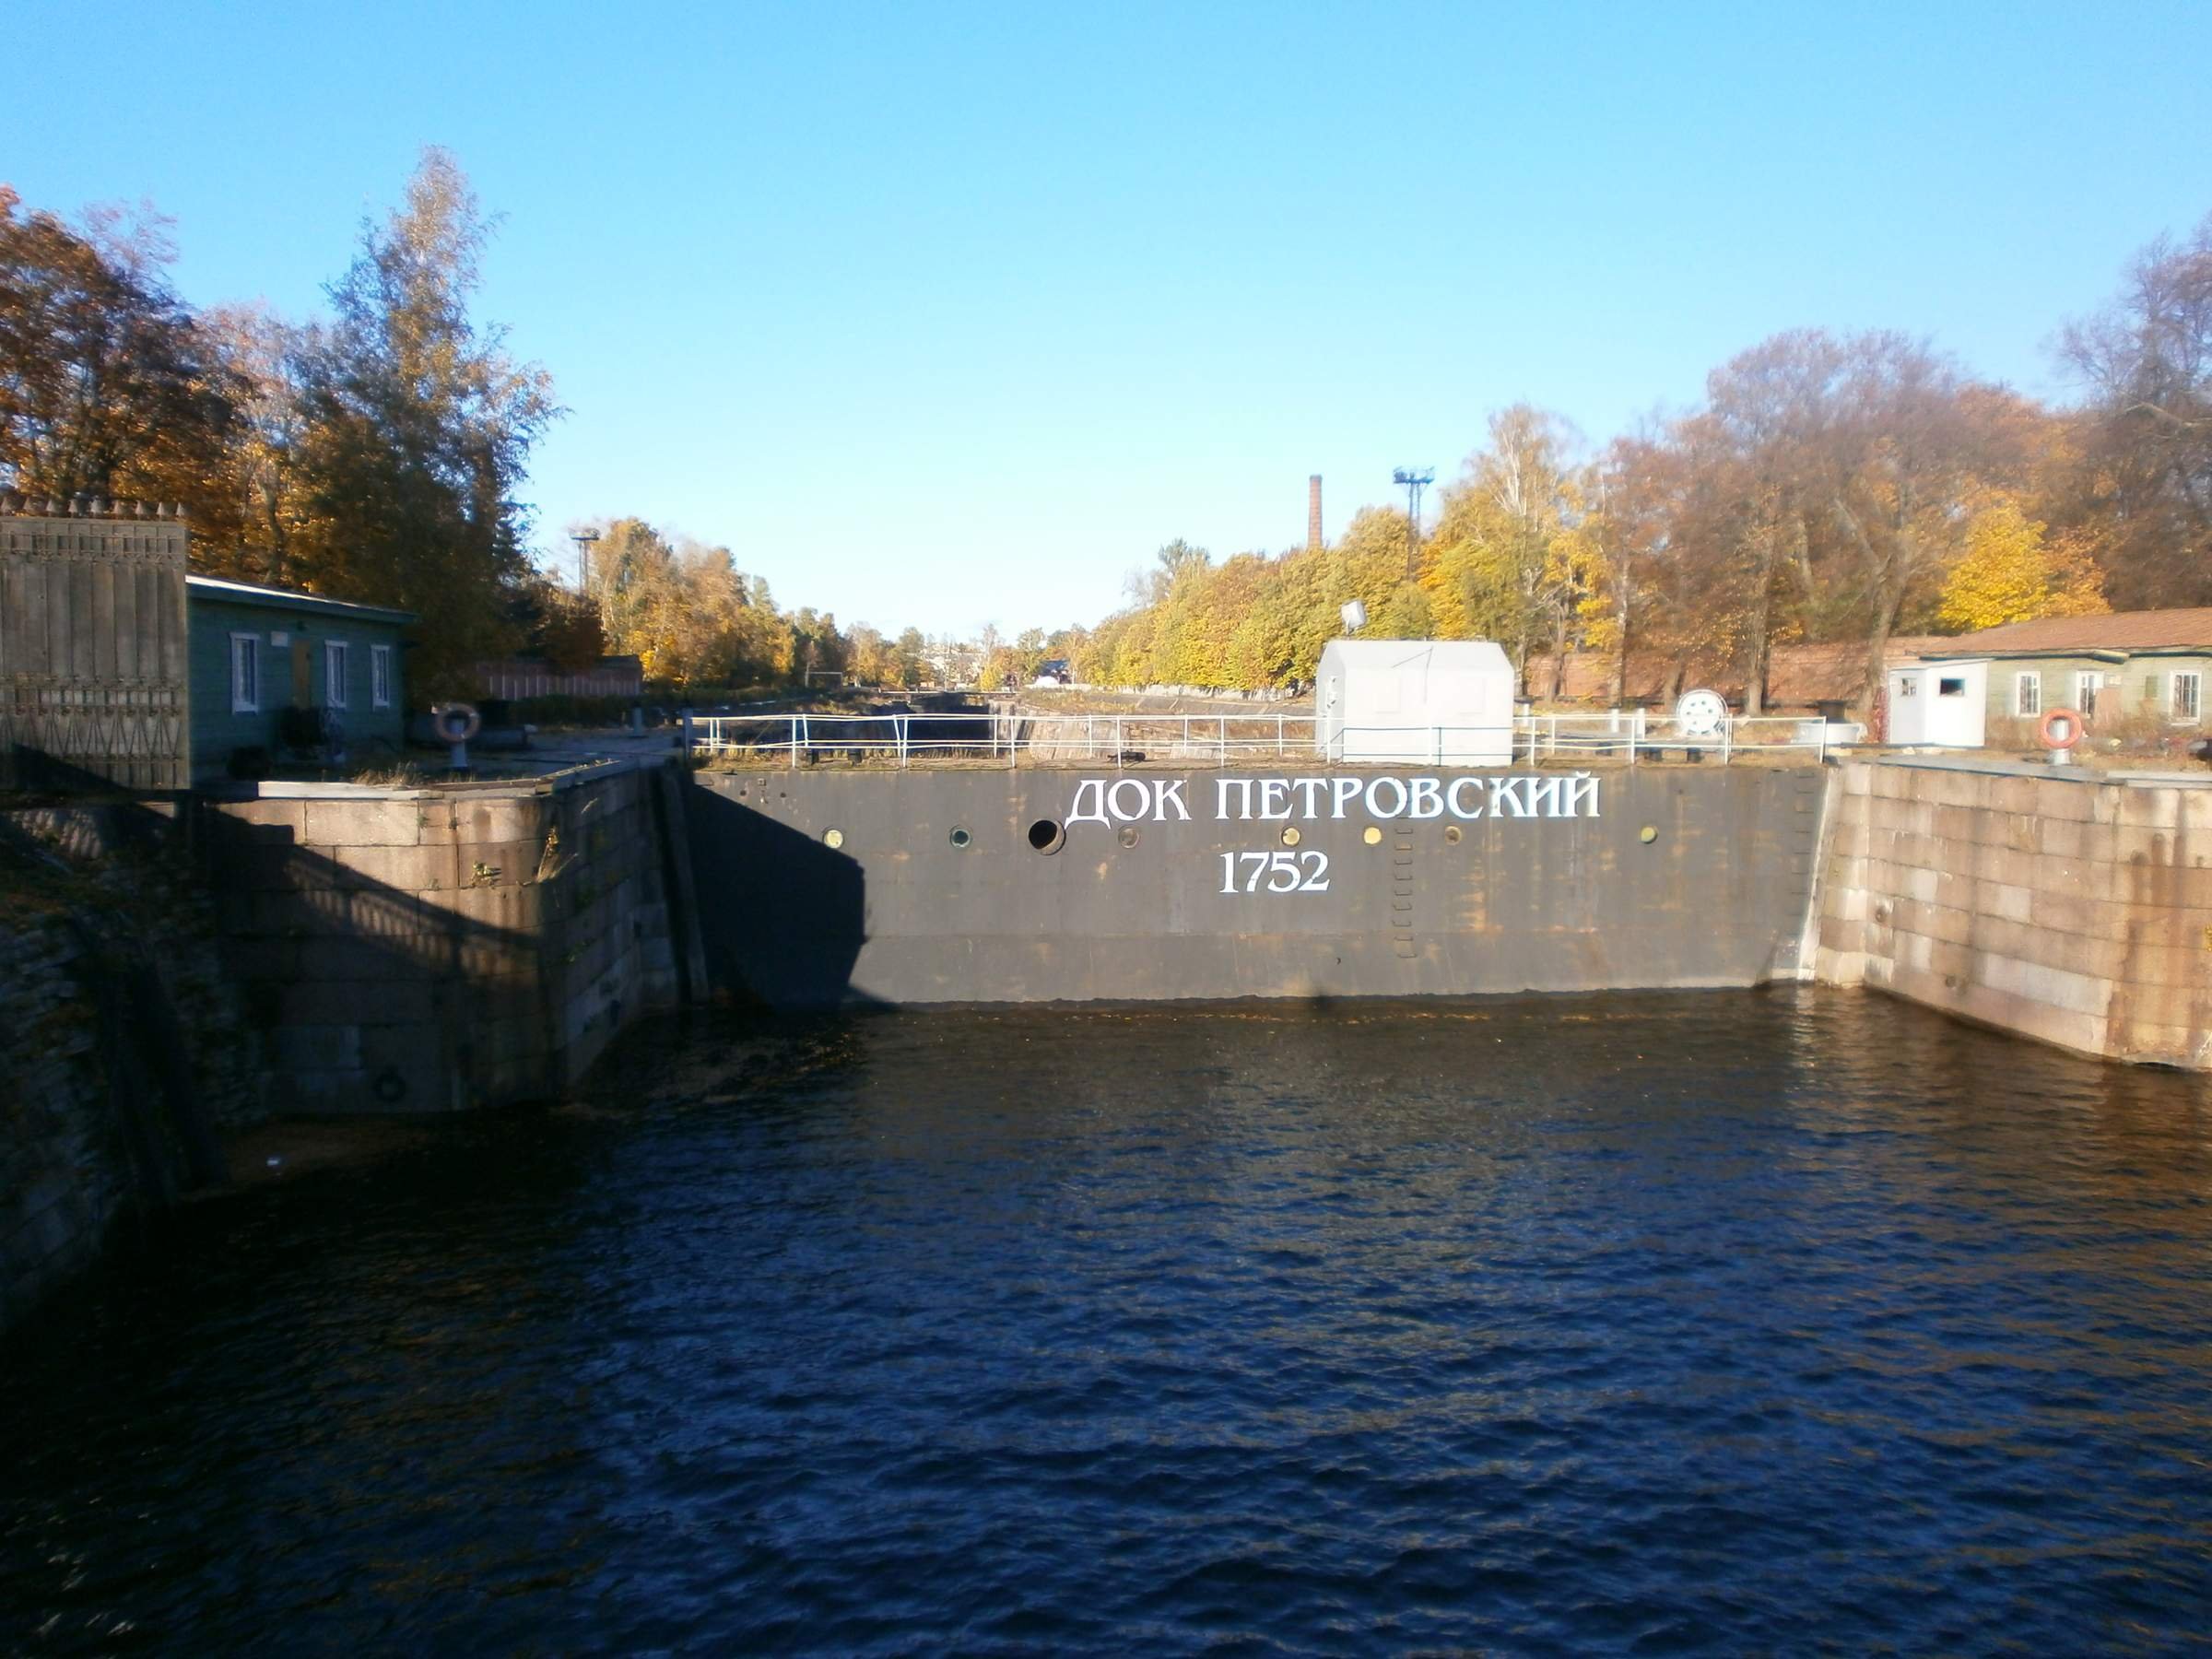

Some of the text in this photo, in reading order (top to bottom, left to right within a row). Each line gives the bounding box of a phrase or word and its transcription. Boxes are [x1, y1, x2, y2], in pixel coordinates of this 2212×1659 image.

[1065, 771, 1601, 830] ДОК ПЕТРОВСКИЙ
[1219, 851, 1330, 893] 1752
